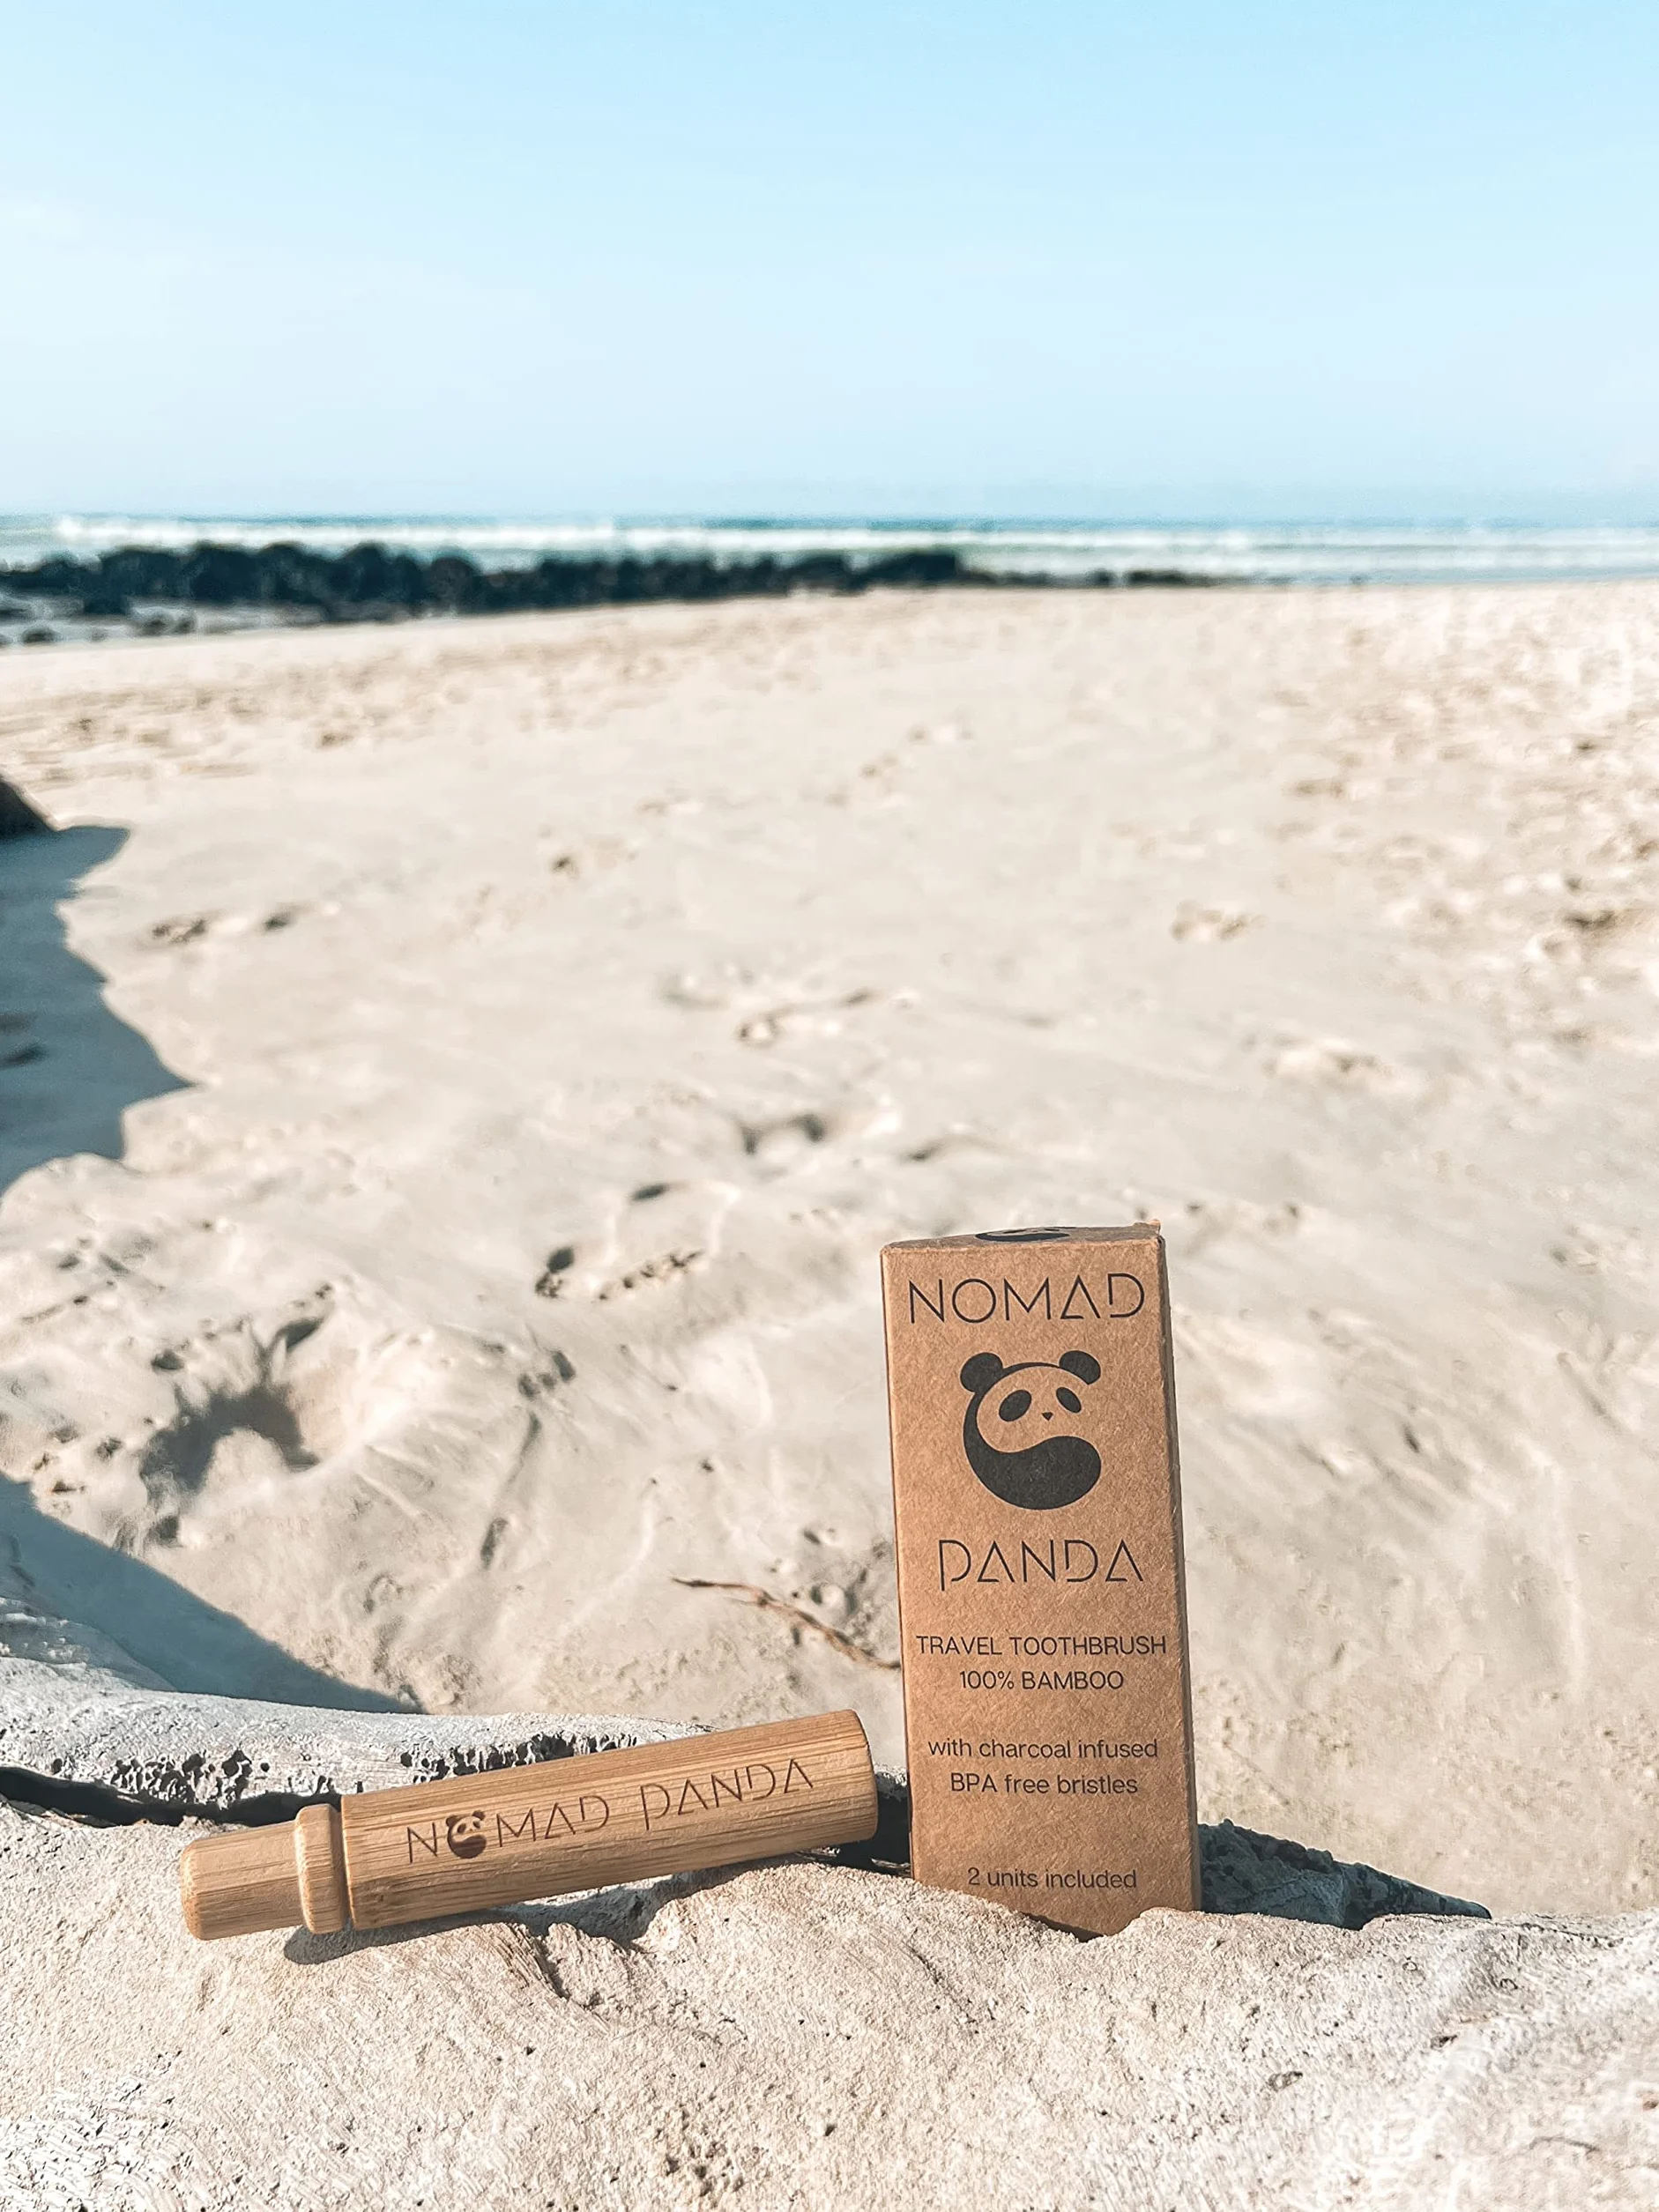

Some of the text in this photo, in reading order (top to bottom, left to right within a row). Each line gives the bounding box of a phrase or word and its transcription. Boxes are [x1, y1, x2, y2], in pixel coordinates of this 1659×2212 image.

[908, 1272, 1145, 1325] NOMAD
[938, 1539, 1144, 1592] PANDA
[916, 1635, 1167, 1656] TRAVEL TOOTHBRUSH
[958, 1670, 1125, 1691] 100% BAMBOO
[927, 1737, 1158, 1759] with charcoal infused
[949, 1771, 1139, 1794] BPA free bristles
[639, 1757, 815, 1831] PANDA
[967, 1867, 1138, 1889] 2 units included
